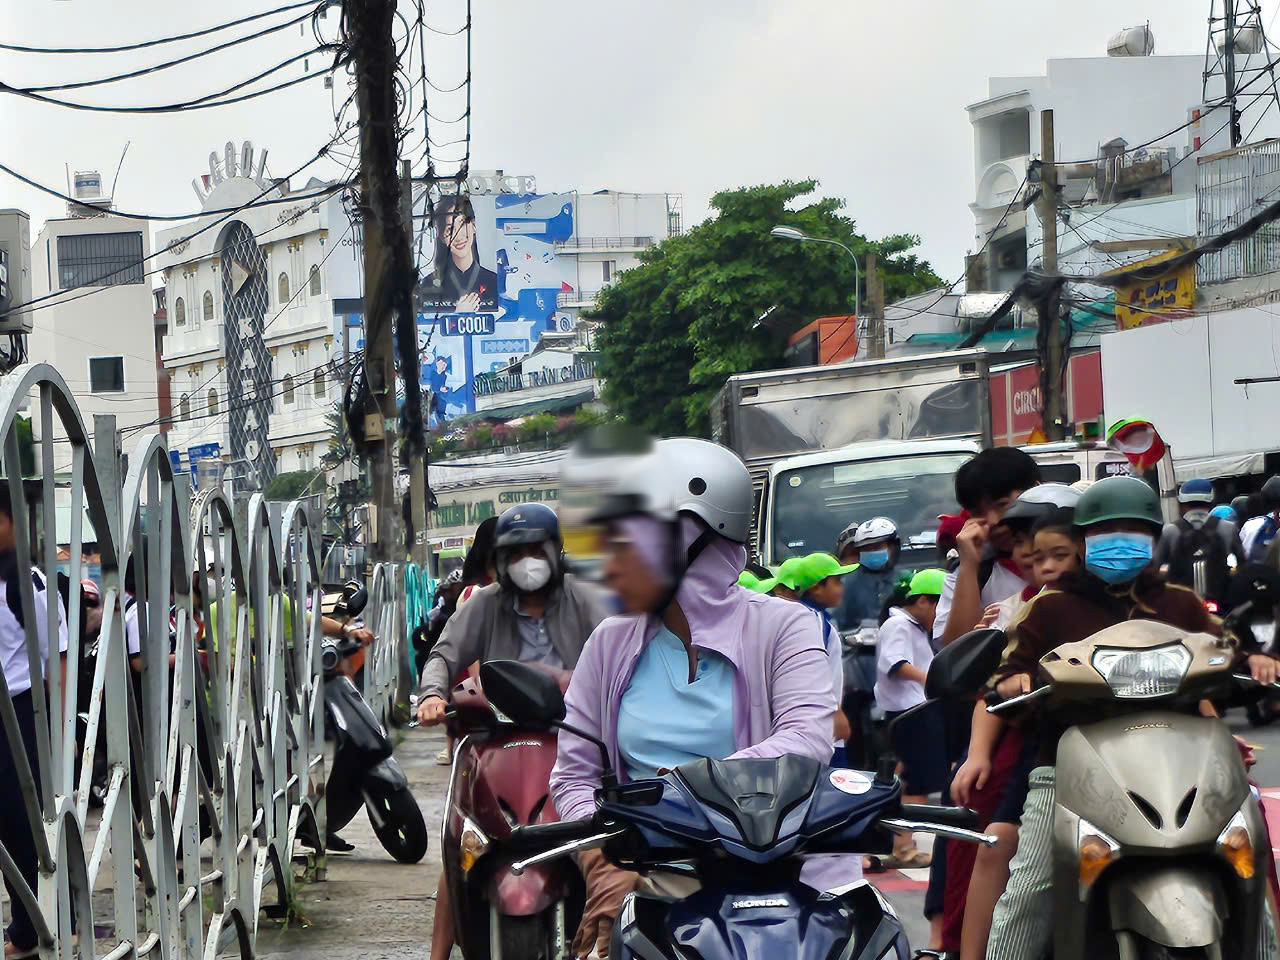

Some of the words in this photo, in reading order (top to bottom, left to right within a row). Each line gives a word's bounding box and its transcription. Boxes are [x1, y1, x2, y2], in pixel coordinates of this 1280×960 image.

[457, 316, 490, 334] COOL
[1013, 387, 1040, 416] CIRC
[732, 898, 790, 909] HONDA
